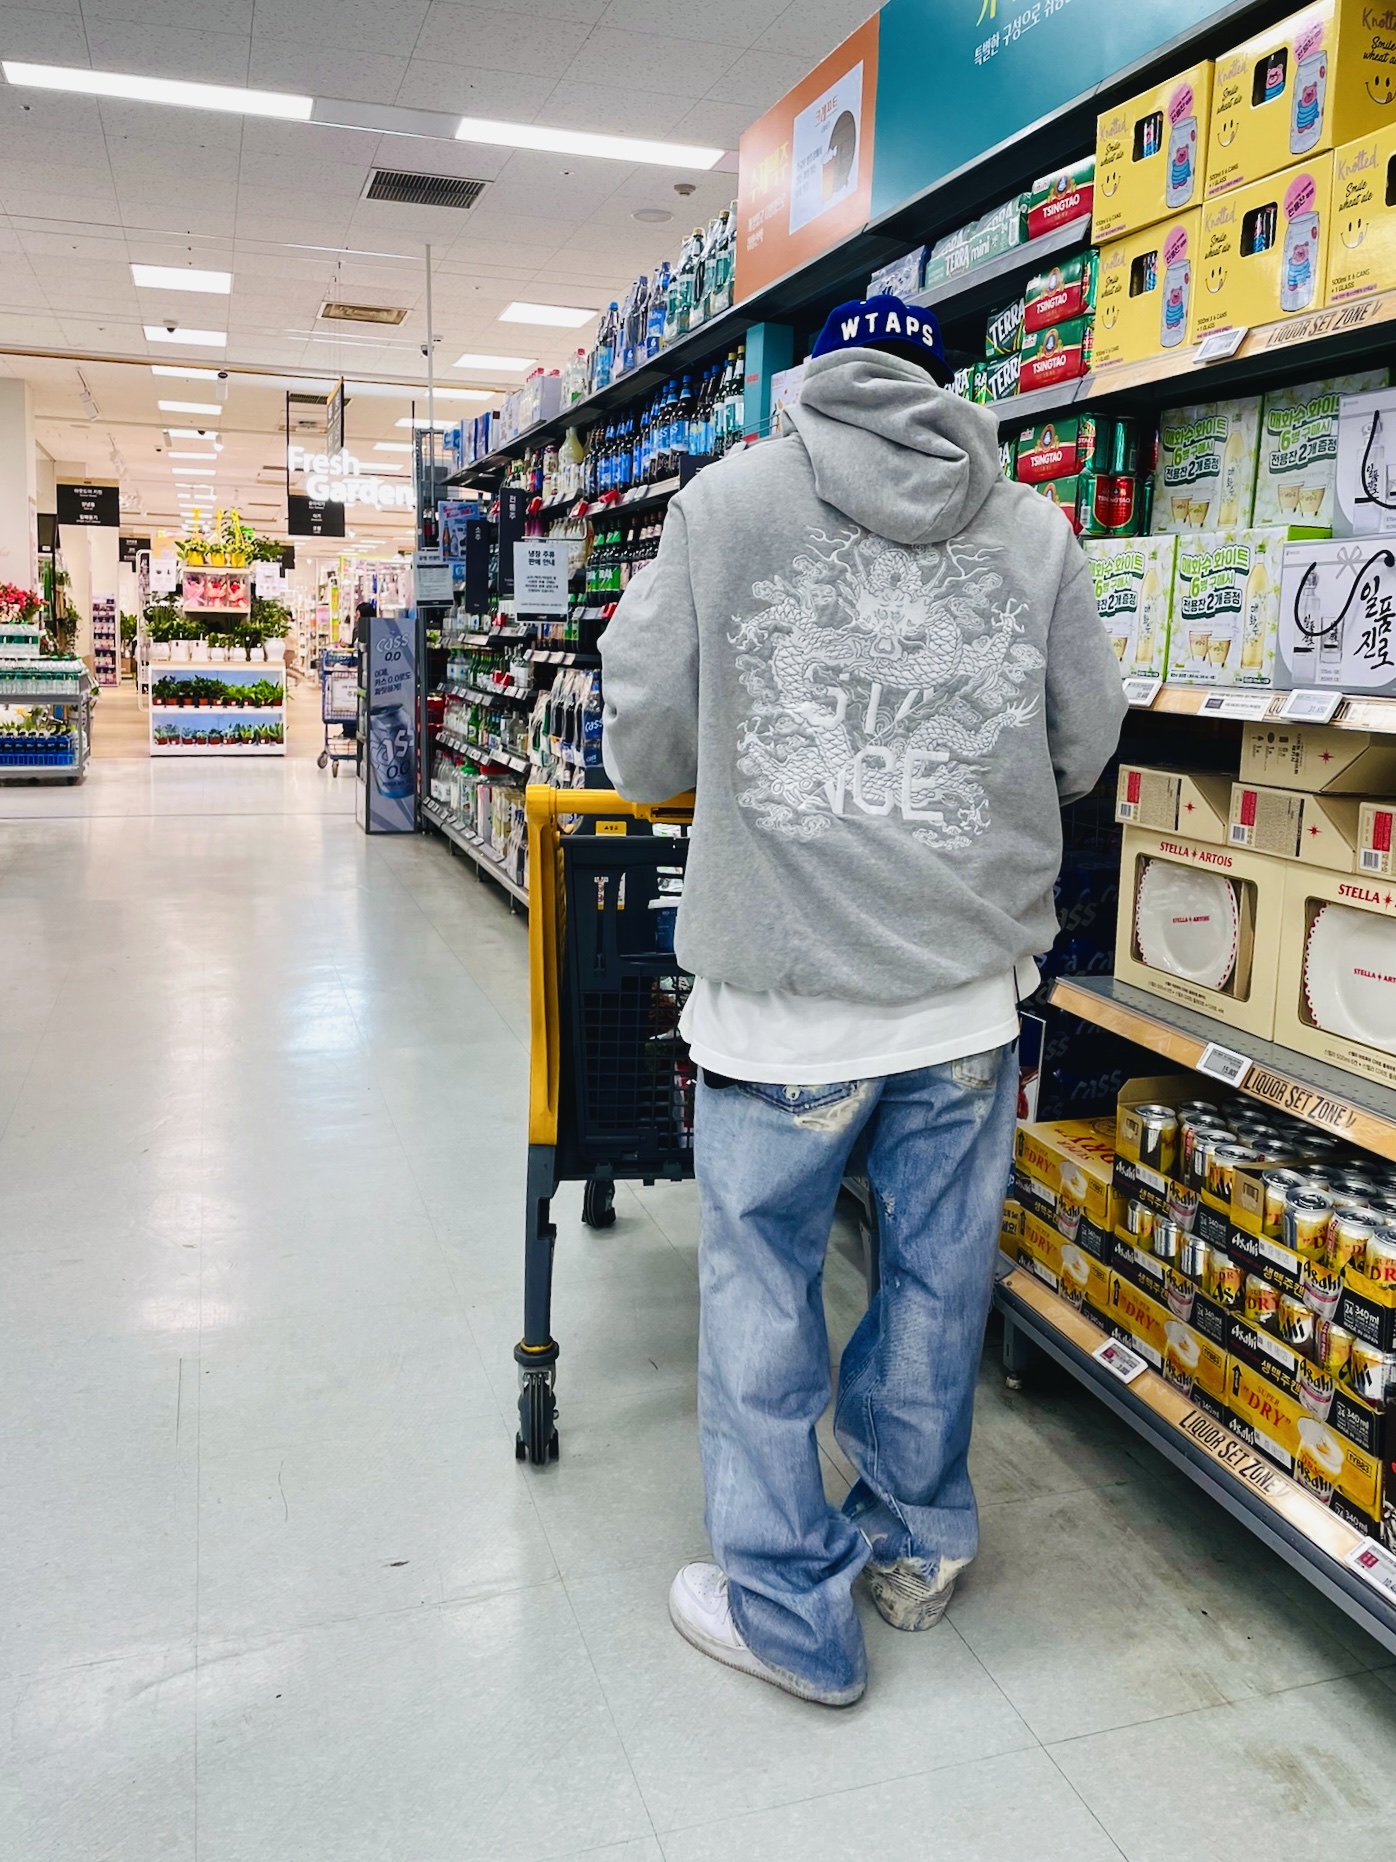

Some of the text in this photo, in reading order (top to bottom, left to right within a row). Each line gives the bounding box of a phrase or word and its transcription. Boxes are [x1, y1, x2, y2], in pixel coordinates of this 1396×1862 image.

[974, 31, 1000, 66] 특별한
[1002, 2, 1041, 46] 구성으로
[1345, 179, 1368, 199] Smile
[1042, 193, 1080, 219] TSINGTAO
[945, 244, 969, 277] TERRA
[969, 236, 991, 262] mini
[1339, 281, 1355, 291] GLASS
[1036, 292, 1068, 314] TSINGTAO
[841, 312, 934, 347] WTAPS
[988, 297, 1025, 349] TERRA
[1266, 319, 1309, 347] LIQUOR
[1309, 314, 1334, 337] SET
[1332, 300, 1373, 331] ZONE
[1032, 354, 1067, 375] TSINGTAO
[1268, 405, 1307, 430] 매화수
[1164, 416, 1227, 447] 매화수 화이트
[288, 445, 360, 477] Fresh
[1030, 450, 1063, 468] TSINGTAO
[1271, 438, 1337, 466] 전용잔 2개 증정
[1165, 456, 1219, 480] 전용잔 2개 증정
[306, 473, 414, 505] Garden
[528, 550, 541, 558] 냉장
[542, 558, 555, 567] 안내
[1113, 552, 1145, 575] 화이트
[1181, 545, 1250, 577] 매화수 화이트
[1208, 570, 1235, 589] 구매시
[1107, 593, 1137, 611] 2개 증정
[1182, 591, 1241, 614] 전용잔 2개 증정
[385, 651, 402, 662] 0.0
[374, 678, 387, 687] 카스
[1160, 841, 1233, 868] STELLA ARTOIS
[1338, 883, 1380, 904] STELLA
[1353, 968, 1376, 979] STELLA
[1243, 1067, 1348, 1127] LIQUOR SET ZONE
[1115, 1160, 1136, 1181] Asahi
[1169, 1180, 1198, 1208] Asahi
[1114, 1242, 1135, 1265] Asahi
[1231, 1232, 1259, 1257] Asahi
[1166, 1268, 1194, 1299] Asahi
[1263, 1264, 1305, 1299] 생맥주캔
[1303, 1259, 1341, 1292] Asahi
[1354, 1304, 1380, 1326] 340ml
[1231, 1324, 1258, 1351] Asahi
[1261, 1360, 1302, 1396] 생맥주캔
[1300, 1358, 1335, 1393] Asahi
[1243, 1385, 1292, 1428] "DRY"
[1257, 1385, 1280, 1406] SUPER
[1346, 1406, 1370, 1430] 340ml
[1229, 1418, 1255, 1446] Asahi
[1179, 1410, 1280, 1493] LIQUOR SET ZONE
[1296, 1459, 1333, 1493] Asahi
[1344, 1509, 1369, 1534] 340ml
